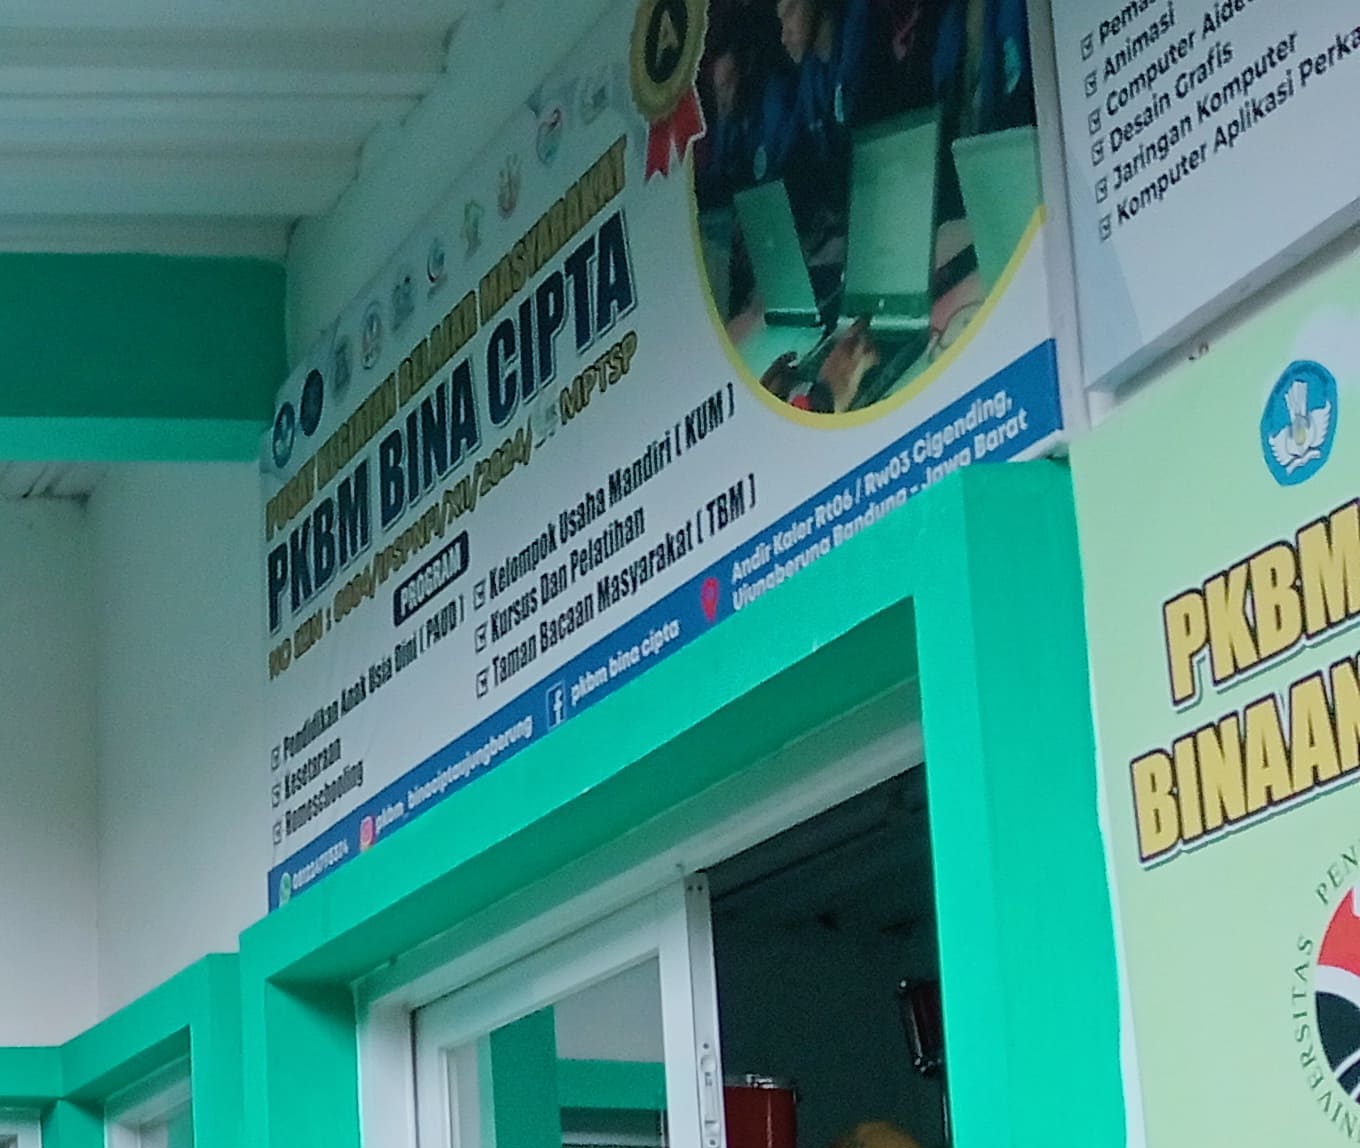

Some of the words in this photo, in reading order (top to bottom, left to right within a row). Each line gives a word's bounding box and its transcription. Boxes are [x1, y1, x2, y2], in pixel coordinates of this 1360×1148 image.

[1099, 0, 1156, 45] Pema
[1102, 1, 1176, 82] Animasi
[1105, 30, 1196, 118] Computer
[1201, 0, 1254, 39] Aide
[1109, 89, 1172, 154] Desain
[1175, 41, 1233, 100] Grafis
[1112, 112, 1193, 193] Jaringan
[1197, 30, 1298, 119] Komputer
[1116, 140, 1208, 226] Komputer
[1213, 69, 1294, 151] Aplikasi
[268, 456, 372, 636] PKBM
[379, 356, 482, 532] BINA
[486, 208, 637, 428] CIPTA
[731, 541, 771, 585] Andir
[815, 490, 852, 529] Rt06
[864, 455, 911, 497] Rw03
[912, 389, 1013, 465] Cigending,
[974, 406, 1029, 459] Barat
[488, 522, 558, 601] Kelompok
[558, 487, 606, 544] Usaha
[608, 430, 673, 508] Mandiri
[685, 389, 724, 449] KUM
[394, 632, 418, 673] Dini
[426, 603, 458, 655] PAUD
[399, 542, 461, 613] PROGRAM
[490, 587, 539, 645] Kursus
[540, 564, 575, 603] Dan
[570, 507, 646, 584] Pelatihan
[492, 633, 537, 688] Taman
[540, 594, 594, 653] Bacaan
[596, 519, 694, 614] Masyarakat
[705, 479, 746, 537] TBM
[1162, 496, 1360, 705] PKBM
[609, 645, 640, 679] bina
[641, 617, 681, 659] cipta
[1292, 933, 1360, 1144] NIVERSITAS
